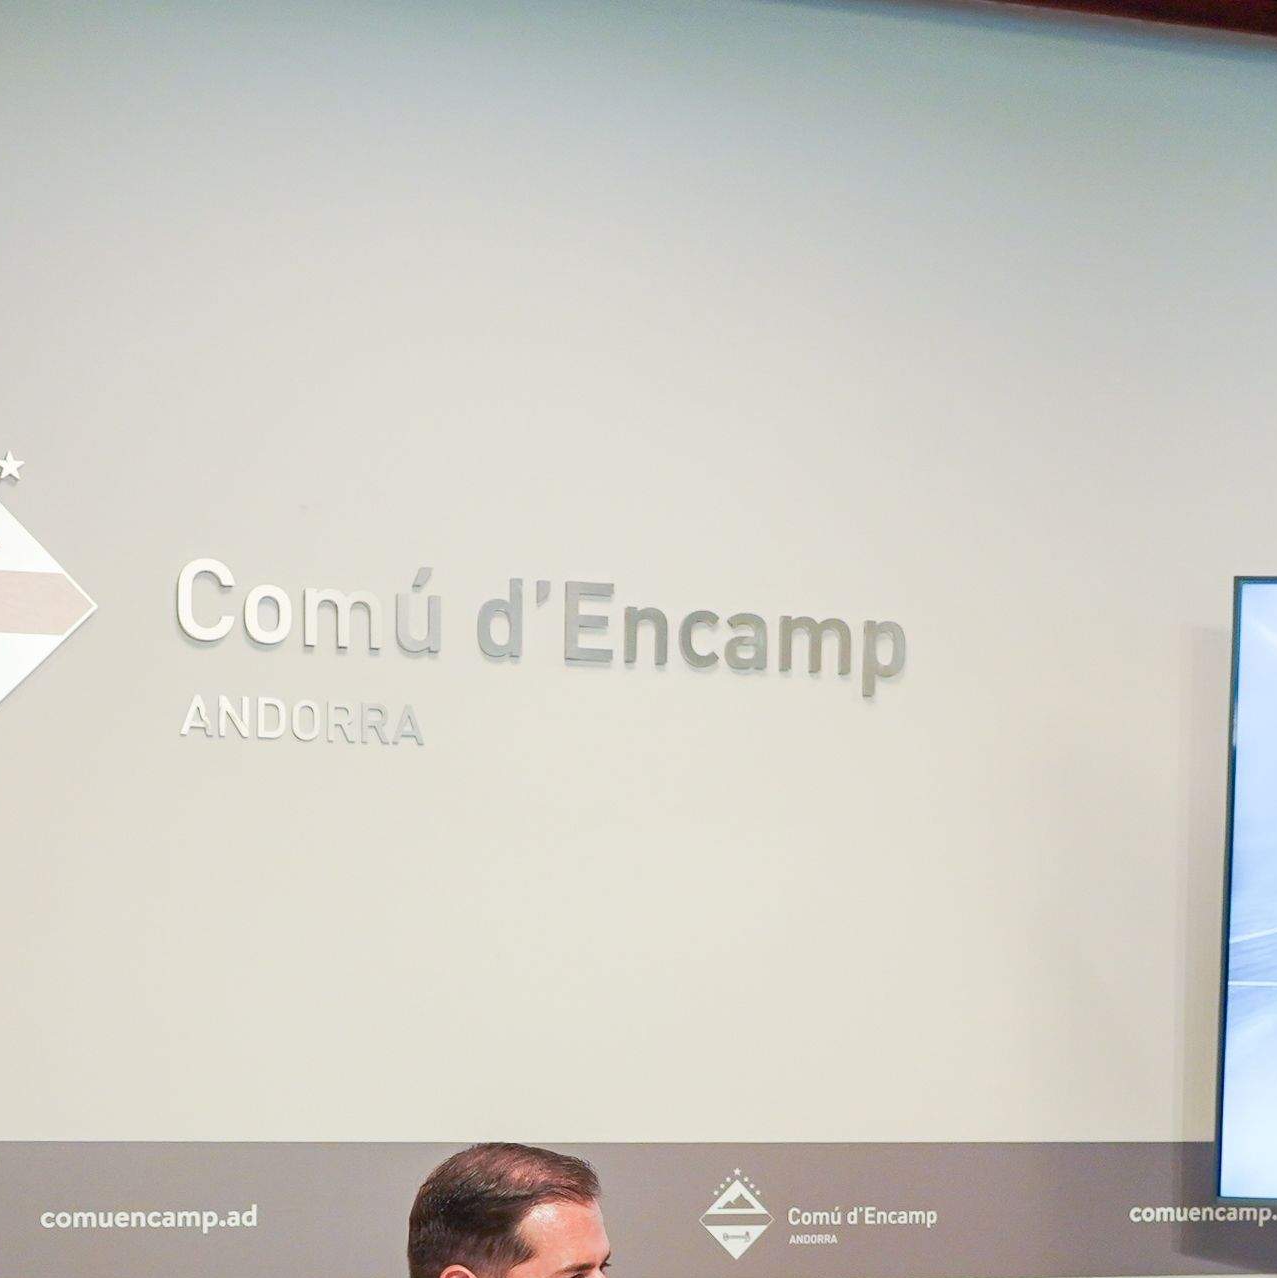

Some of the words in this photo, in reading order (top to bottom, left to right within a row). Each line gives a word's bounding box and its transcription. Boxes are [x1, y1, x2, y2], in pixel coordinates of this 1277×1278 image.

[175, 557, 442, 657] Comú
[476, 577, 908, 699] d'Encamp
[179, 693, 426, 747] ANDORRA
[39, 1204, 259, 1235] comuencamp.ad
[787, 1206, 842, 1226] Comú
[846, 1206, 938, 1229] d'Encamp
[789, 1234, 839, 1245] ANDORRA
